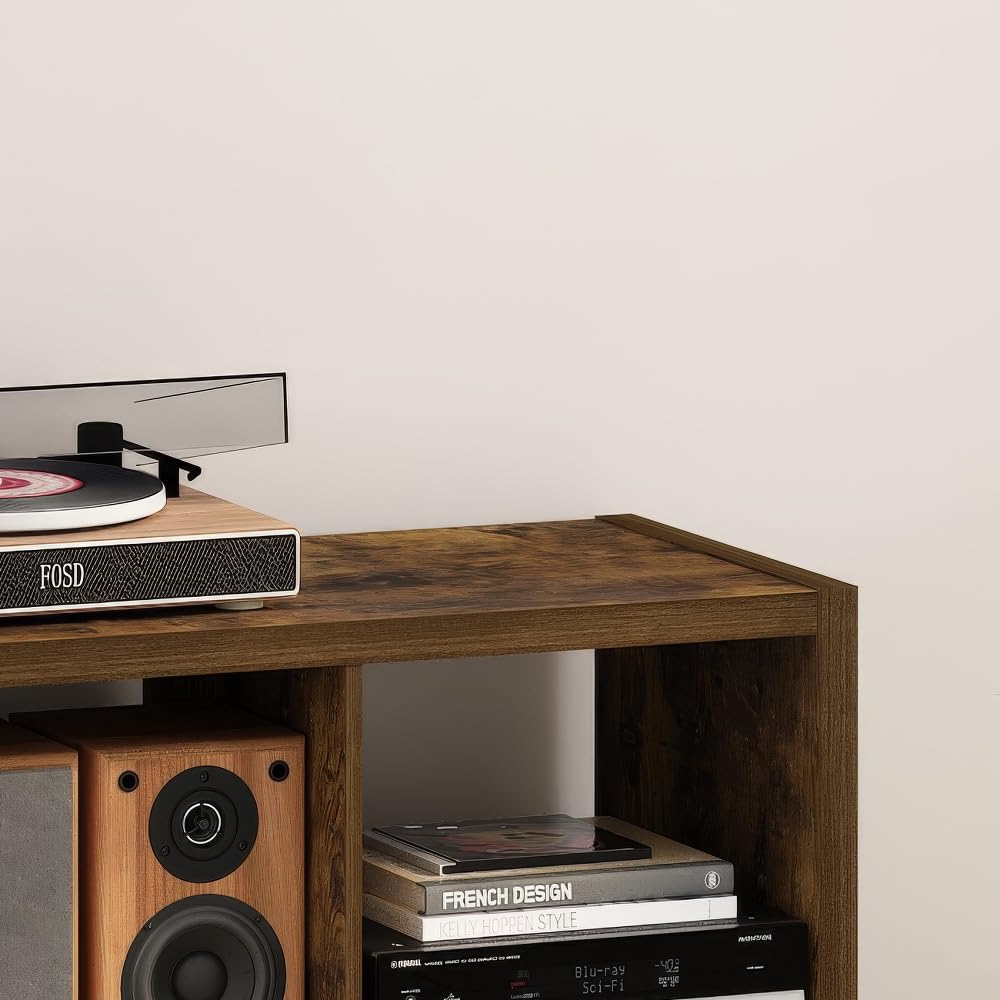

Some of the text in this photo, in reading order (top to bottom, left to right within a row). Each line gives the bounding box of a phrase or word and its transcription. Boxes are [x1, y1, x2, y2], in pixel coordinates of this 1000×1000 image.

[40, 562, 84, 589] FOSD
[442, 882, 573, 910] FRENCH DESIGN
[440, 911, 578, 938] KELLY HOPPEN STYLE
[575, 965, 625, 979] Blu-ray
[582, 979, 624, 994] Sci-Fi
